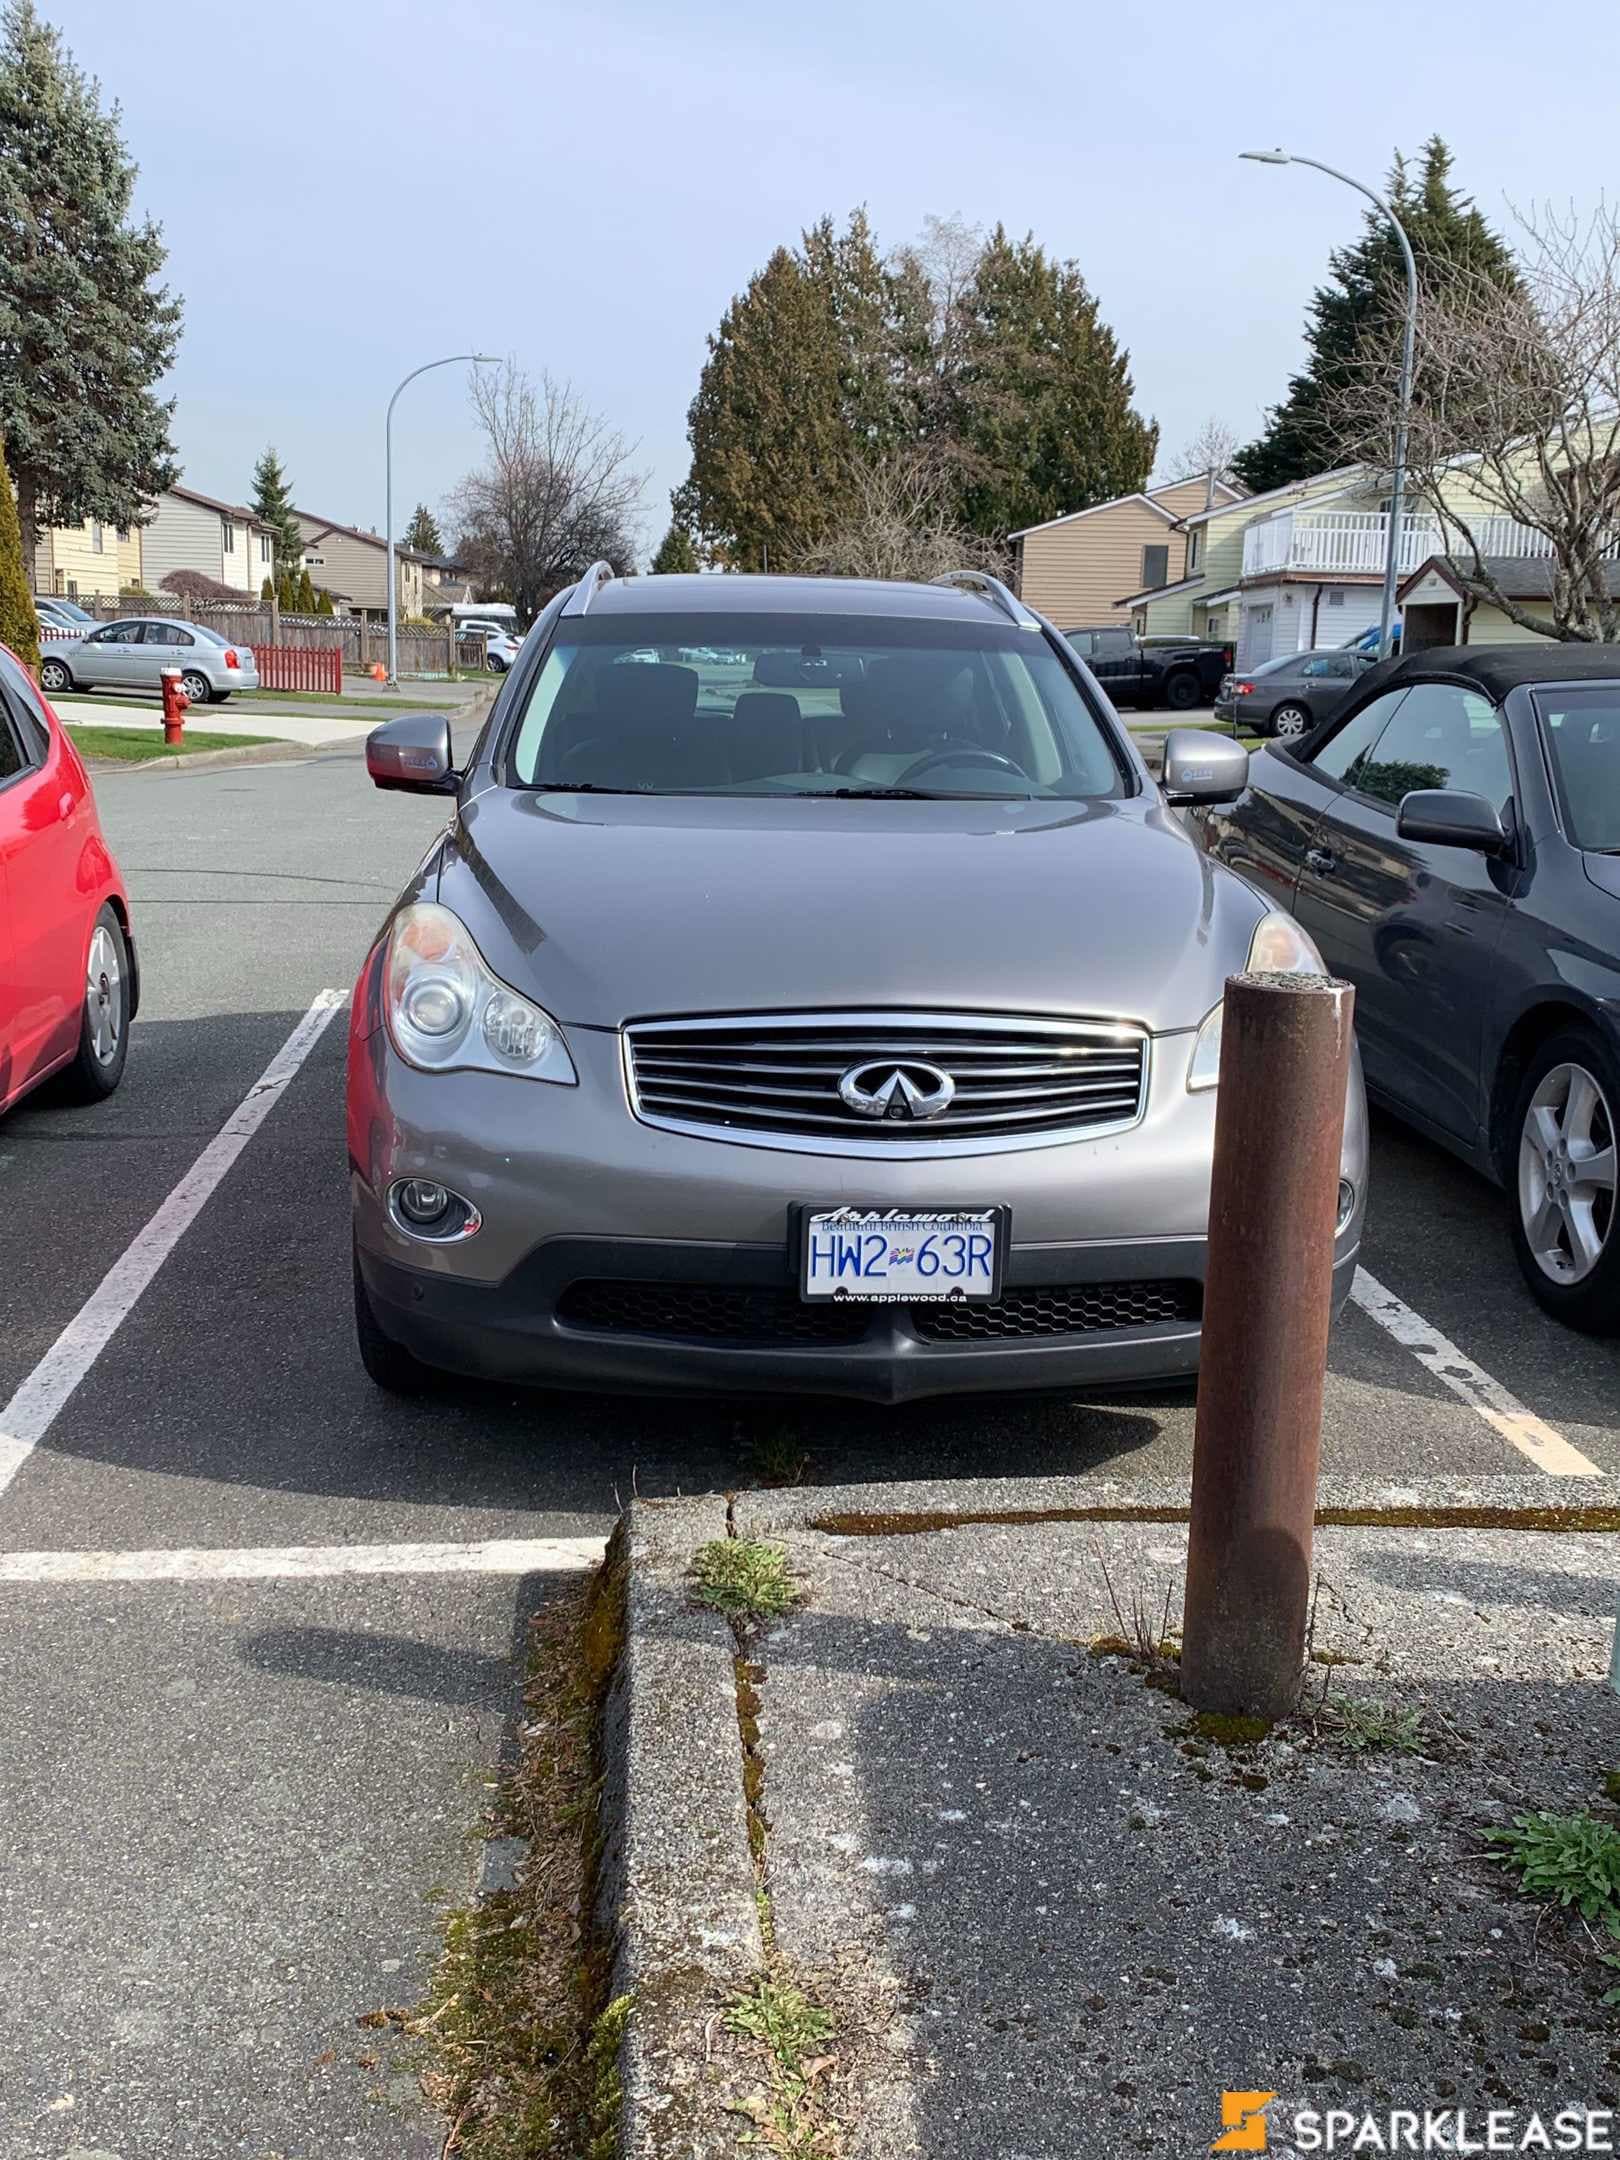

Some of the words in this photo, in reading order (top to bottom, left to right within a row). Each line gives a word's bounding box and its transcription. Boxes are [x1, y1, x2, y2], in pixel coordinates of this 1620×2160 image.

[811, 1234, 888, 1277] HW2
[916, 1234, 992, 1277] 63R
[833, 1295, 967, 1303] www.applewood.ca
